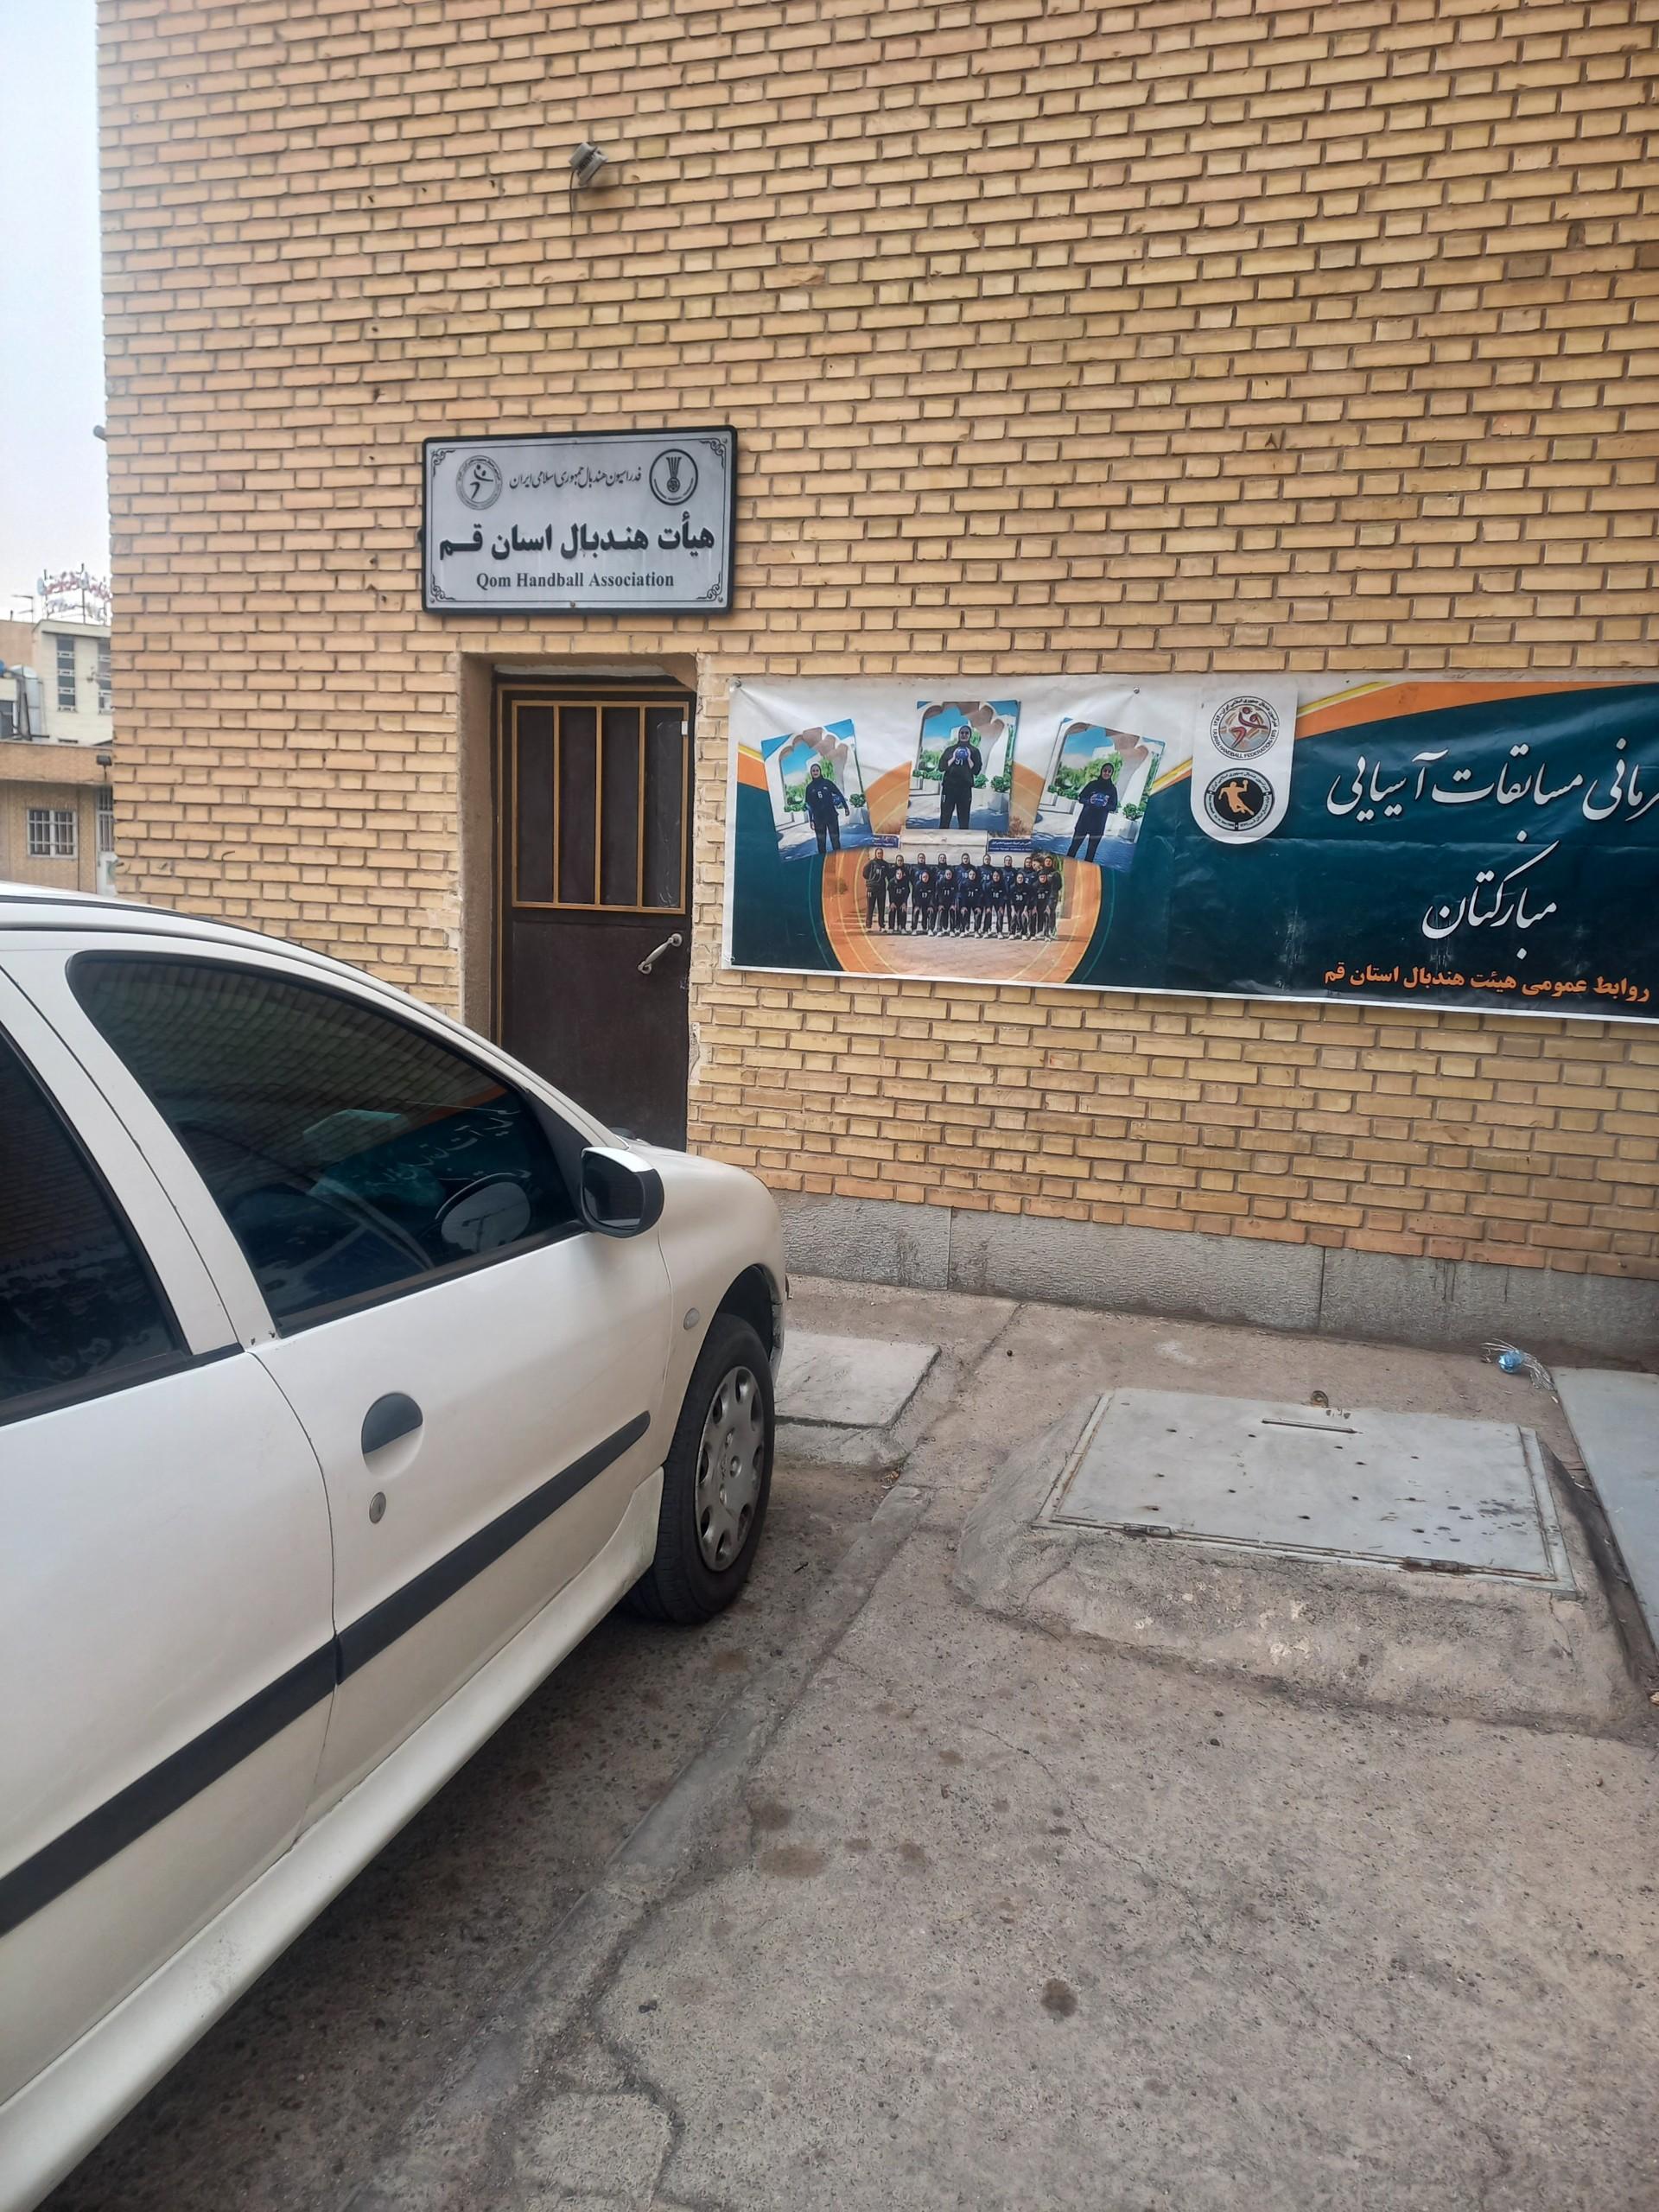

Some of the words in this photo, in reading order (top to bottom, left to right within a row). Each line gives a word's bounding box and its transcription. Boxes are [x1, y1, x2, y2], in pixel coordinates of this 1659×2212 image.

[509, 474, 533, 489] ایران
[605, 466, 642, 487] فدراسیون
[439, 523, 484, 560] قم
[561, 523, 649, 560] هندبال
[476, 572, 512, 591] Qom
[517, 572, 584, 588] Handball
[588, 571, 674, 588] Association
[1326, 749, 1449, 823] آسیایی
[1432, 743, 1584, 842] مسابقات
[1421, 839, 1560, 961] مبارکتان
[1325, 962, 1345, 984] قم
[1350, 964, 1399, 985] استان
[1403, 966, 1465, 988] هندبال
[1470, 970, 1516, 993] هیئت
[1522, 979, 1587, 998] عمومی
[1593, 976, 1649, 1002] روابط
